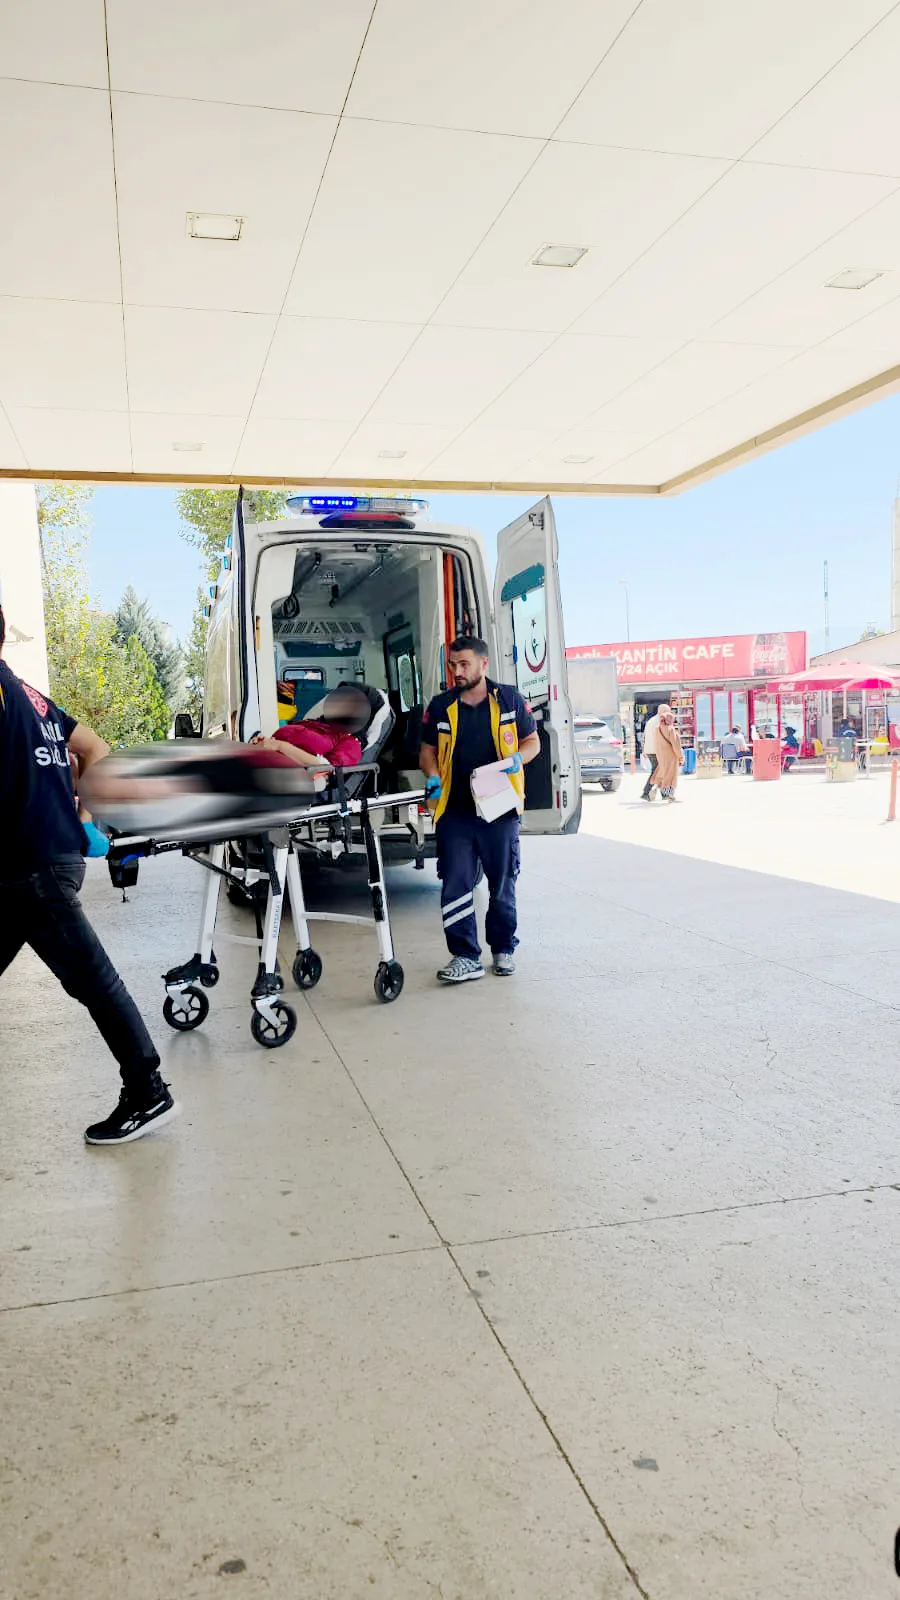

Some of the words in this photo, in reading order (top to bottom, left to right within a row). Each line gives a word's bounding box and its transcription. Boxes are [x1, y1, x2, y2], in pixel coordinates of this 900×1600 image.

[610, 644, 676, 664] KANTİN
[682, 643, 735, 660] CAFE
[646, 662, 679, 676] AÇIK
